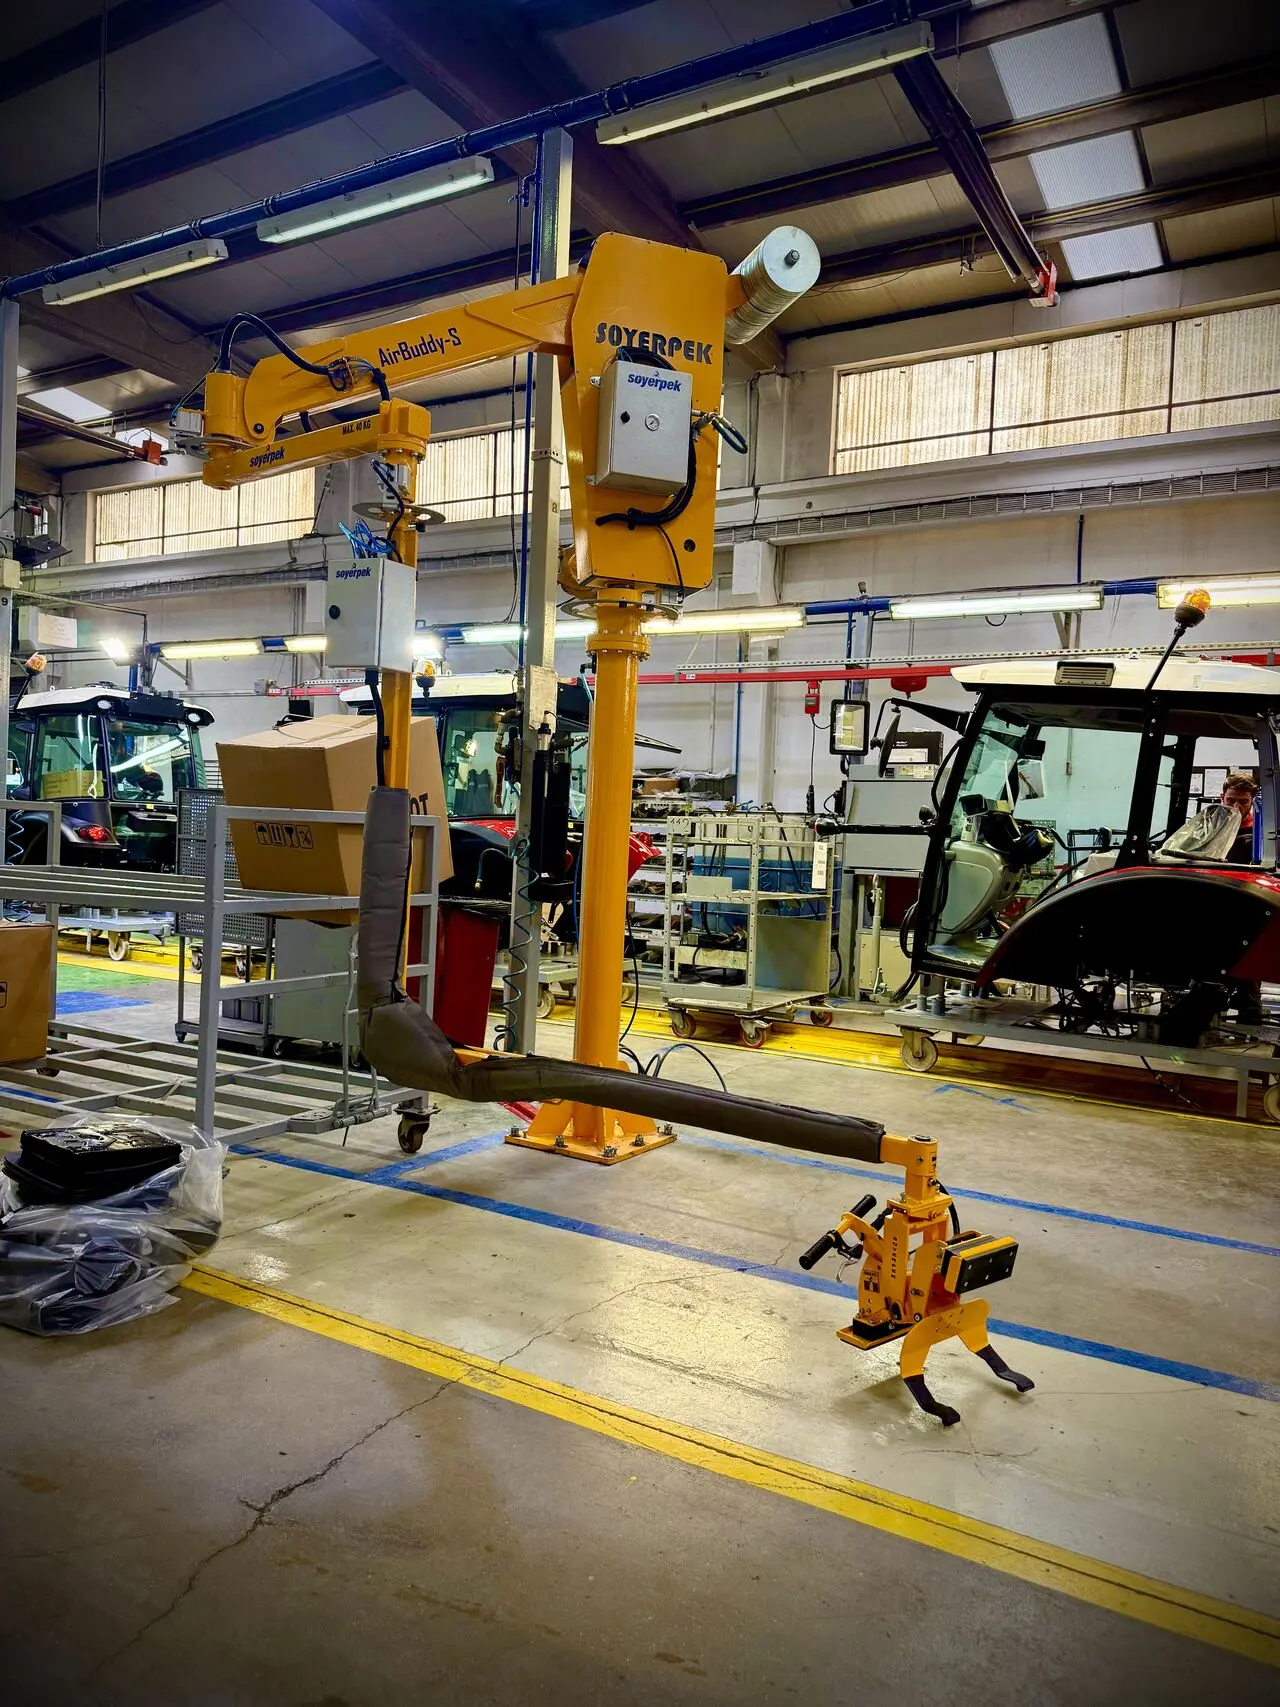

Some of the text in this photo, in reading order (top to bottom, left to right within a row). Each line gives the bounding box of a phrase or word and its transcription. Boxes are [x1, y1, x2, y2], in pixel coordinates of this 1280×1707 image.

[378, 327, 462, 368] AirBuddy-S
[595, 322, 713, 365] SOYERPEK
[627, 373, 682, 392] soyerpek
[249, 446, 285, 468] soyerpek
[335, 566, 371, 580] soyerpek
[1, 597, 9, 606] 9
